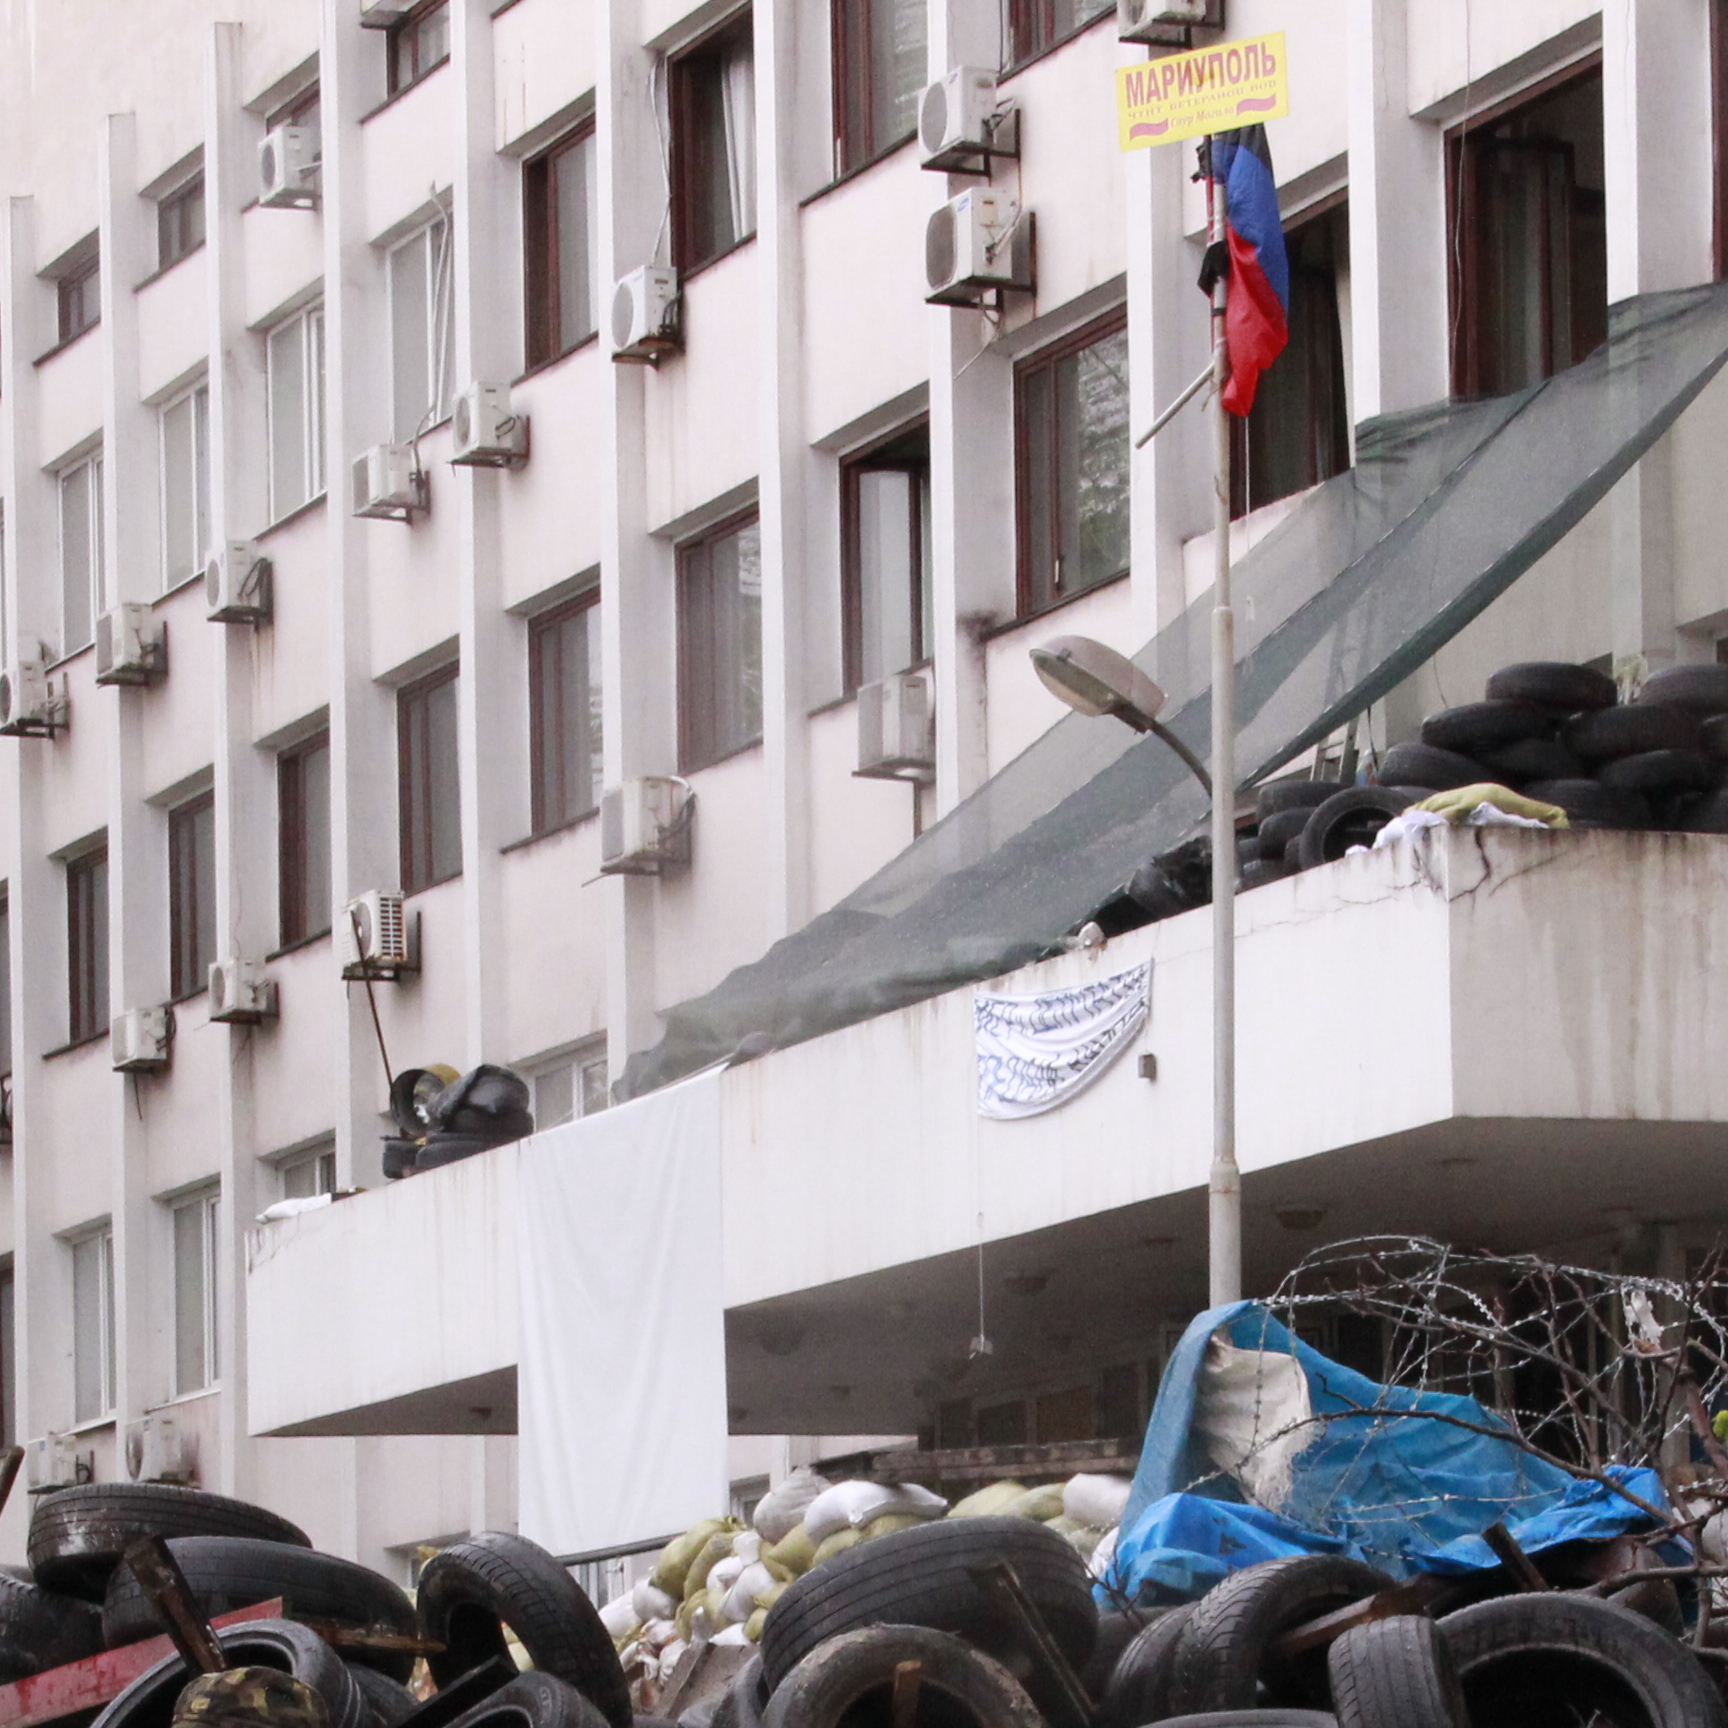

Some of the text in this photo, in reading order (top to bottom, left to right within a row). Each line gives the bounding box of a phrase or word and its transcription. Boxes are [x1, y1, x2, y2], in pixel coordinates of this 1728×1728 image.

[1125, 42, 1276, 108] МАРИУПОЛЬ
[1128, 107, 1162, 118] ЧТИТ
[1169, 89, 1244, 110] ВЕТЕРАНОВ
